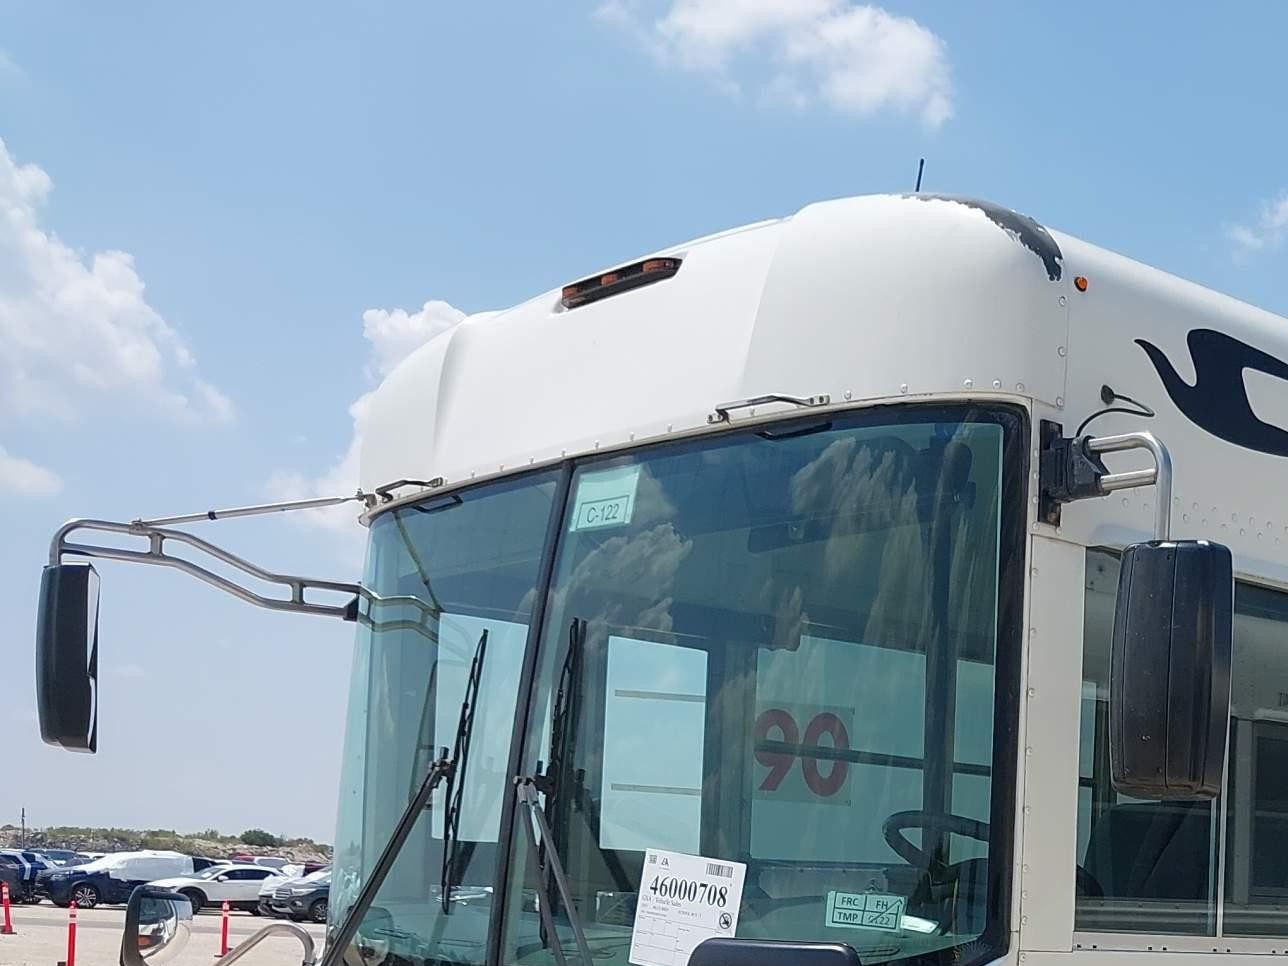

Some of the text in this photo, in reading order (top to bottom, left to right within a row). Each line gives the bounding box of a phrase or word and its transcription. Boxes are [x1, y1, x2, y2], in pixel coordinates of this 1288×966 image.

[587, 504, 619, 523] C-122
[753, 708, 849, 797] 90
[650, 875, 728, 908] 46000708
[841, 896, 889, 910] FRC FH
[837, 912, 858, 922] TMP
